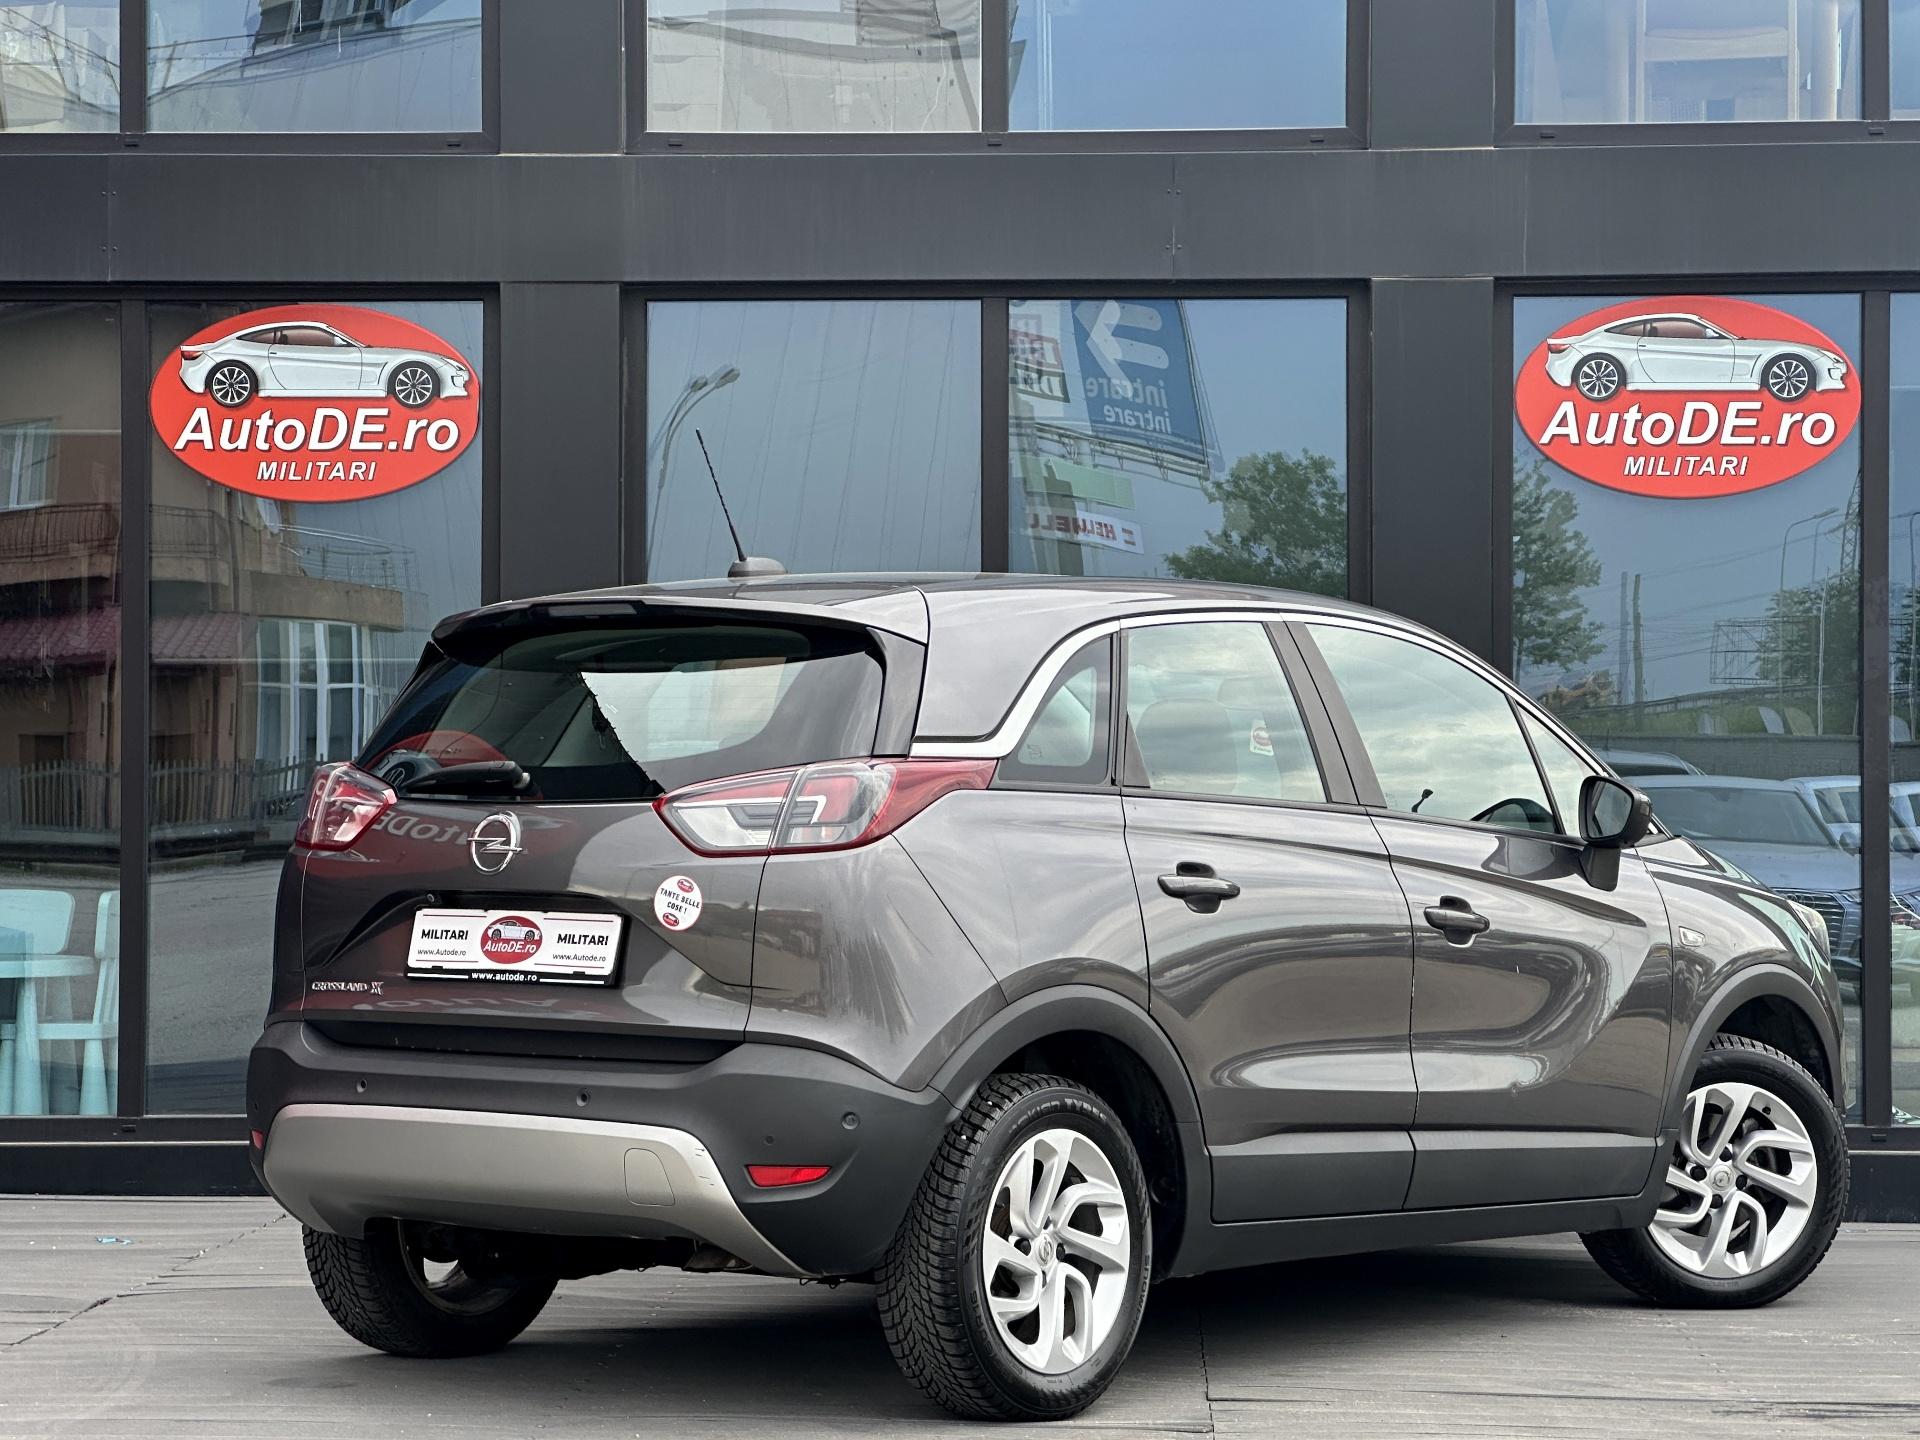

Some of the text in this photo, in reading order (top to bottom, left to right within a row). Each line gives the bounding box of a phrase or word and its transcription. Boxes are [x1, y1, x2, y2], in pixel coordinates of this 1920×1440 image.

[173, 406, 461, 451] AutoDE.ro
[1539, 400, 1837, 446] AutoDE.ro
[256, 461, 377, 481] MILITARI
[1623, 456, 1749, 477] MILITARI
[660, 887, 681, 901] TANTE
[681, 895, 701, 908] BELLE
[667, 901, 683, 912] COSE
[421, 929, 469, 940] MILITARI
[557, 933, 609, 946] MILITARI
[417, 948, 467, 956] www.Autode.ro
[484, 940, 537, 954] AutoDE.ro
[552, 953, 607, 962] www.Autode.ro
[471, 972, 538, 982] www.autode.ro
[311, 981, 385, 995] CROSSLAND X
